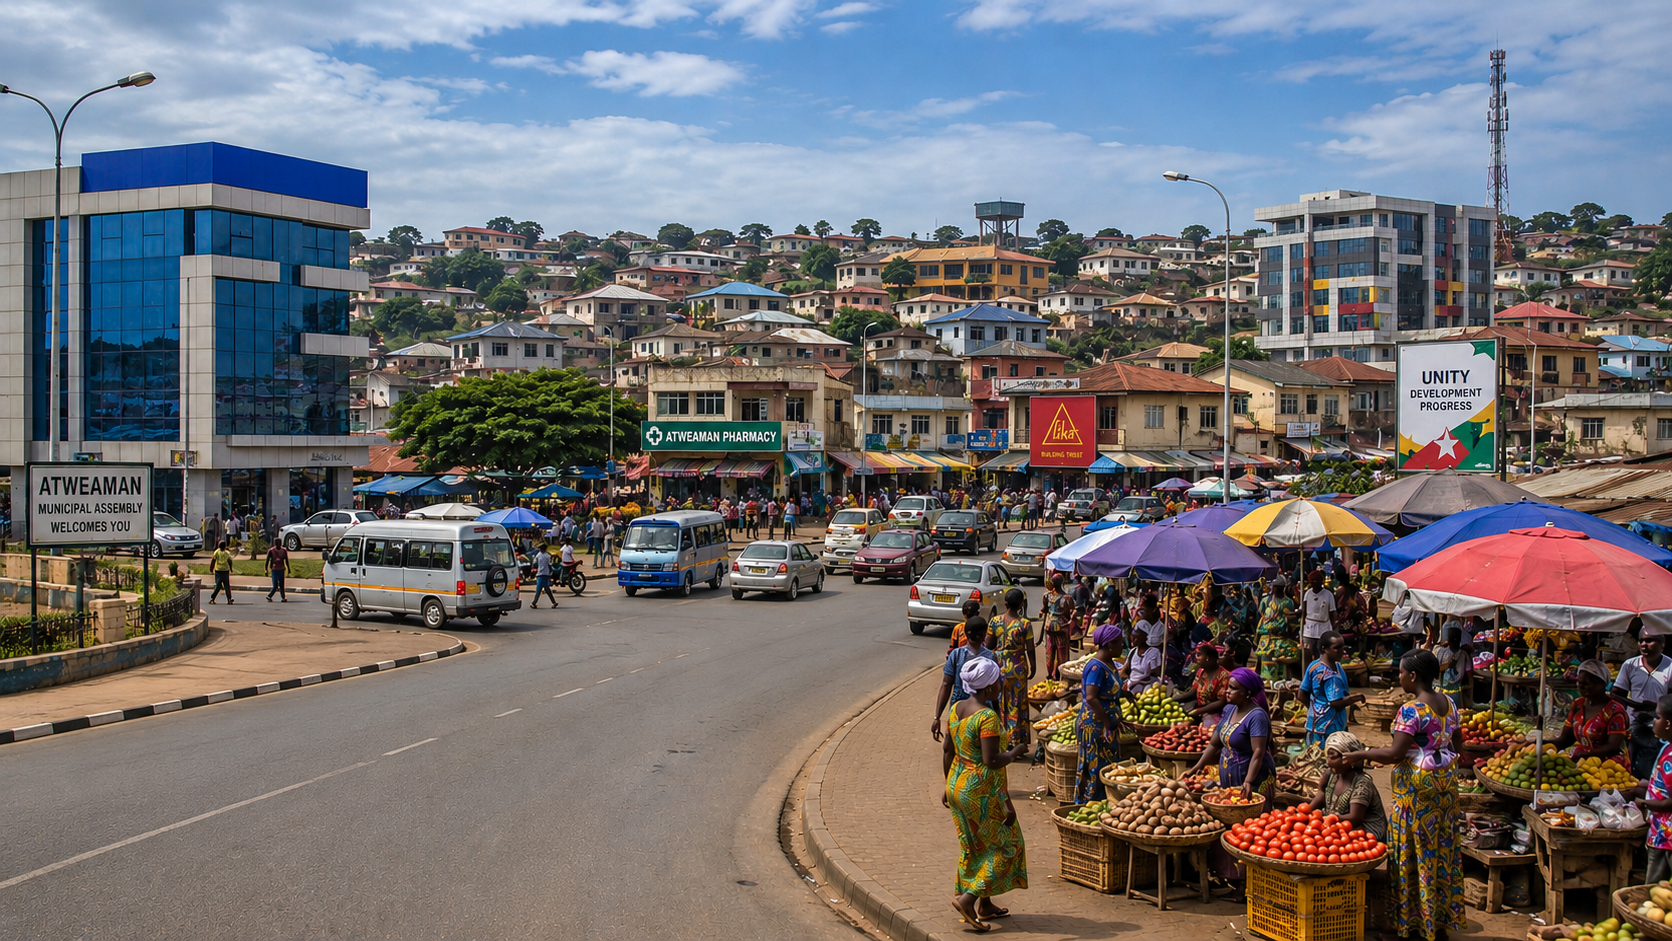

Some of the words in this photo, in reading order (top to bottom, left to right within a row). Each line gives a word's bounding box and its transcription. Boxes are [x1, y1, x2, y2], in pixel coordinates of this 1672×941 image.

[1422, 370, 1471, 384] UNITY
[1410, 388, 1482, 398] DEVELOPMENT
[1420, 401, 1472, 411] PROGRESS
[665, 431, 720, 443] ATWEAMAN
[722, 431, 777, 443] PHARMACY
[39, 476, 142, 496] ATWEAMAN
[38, 503, 92, 514] MUNICIPAL
[94, 502, 143, 514] ASSEMBLY
[51, 521, 107, 533] WELCOMES
[110, 521, 131, 532] YOU
